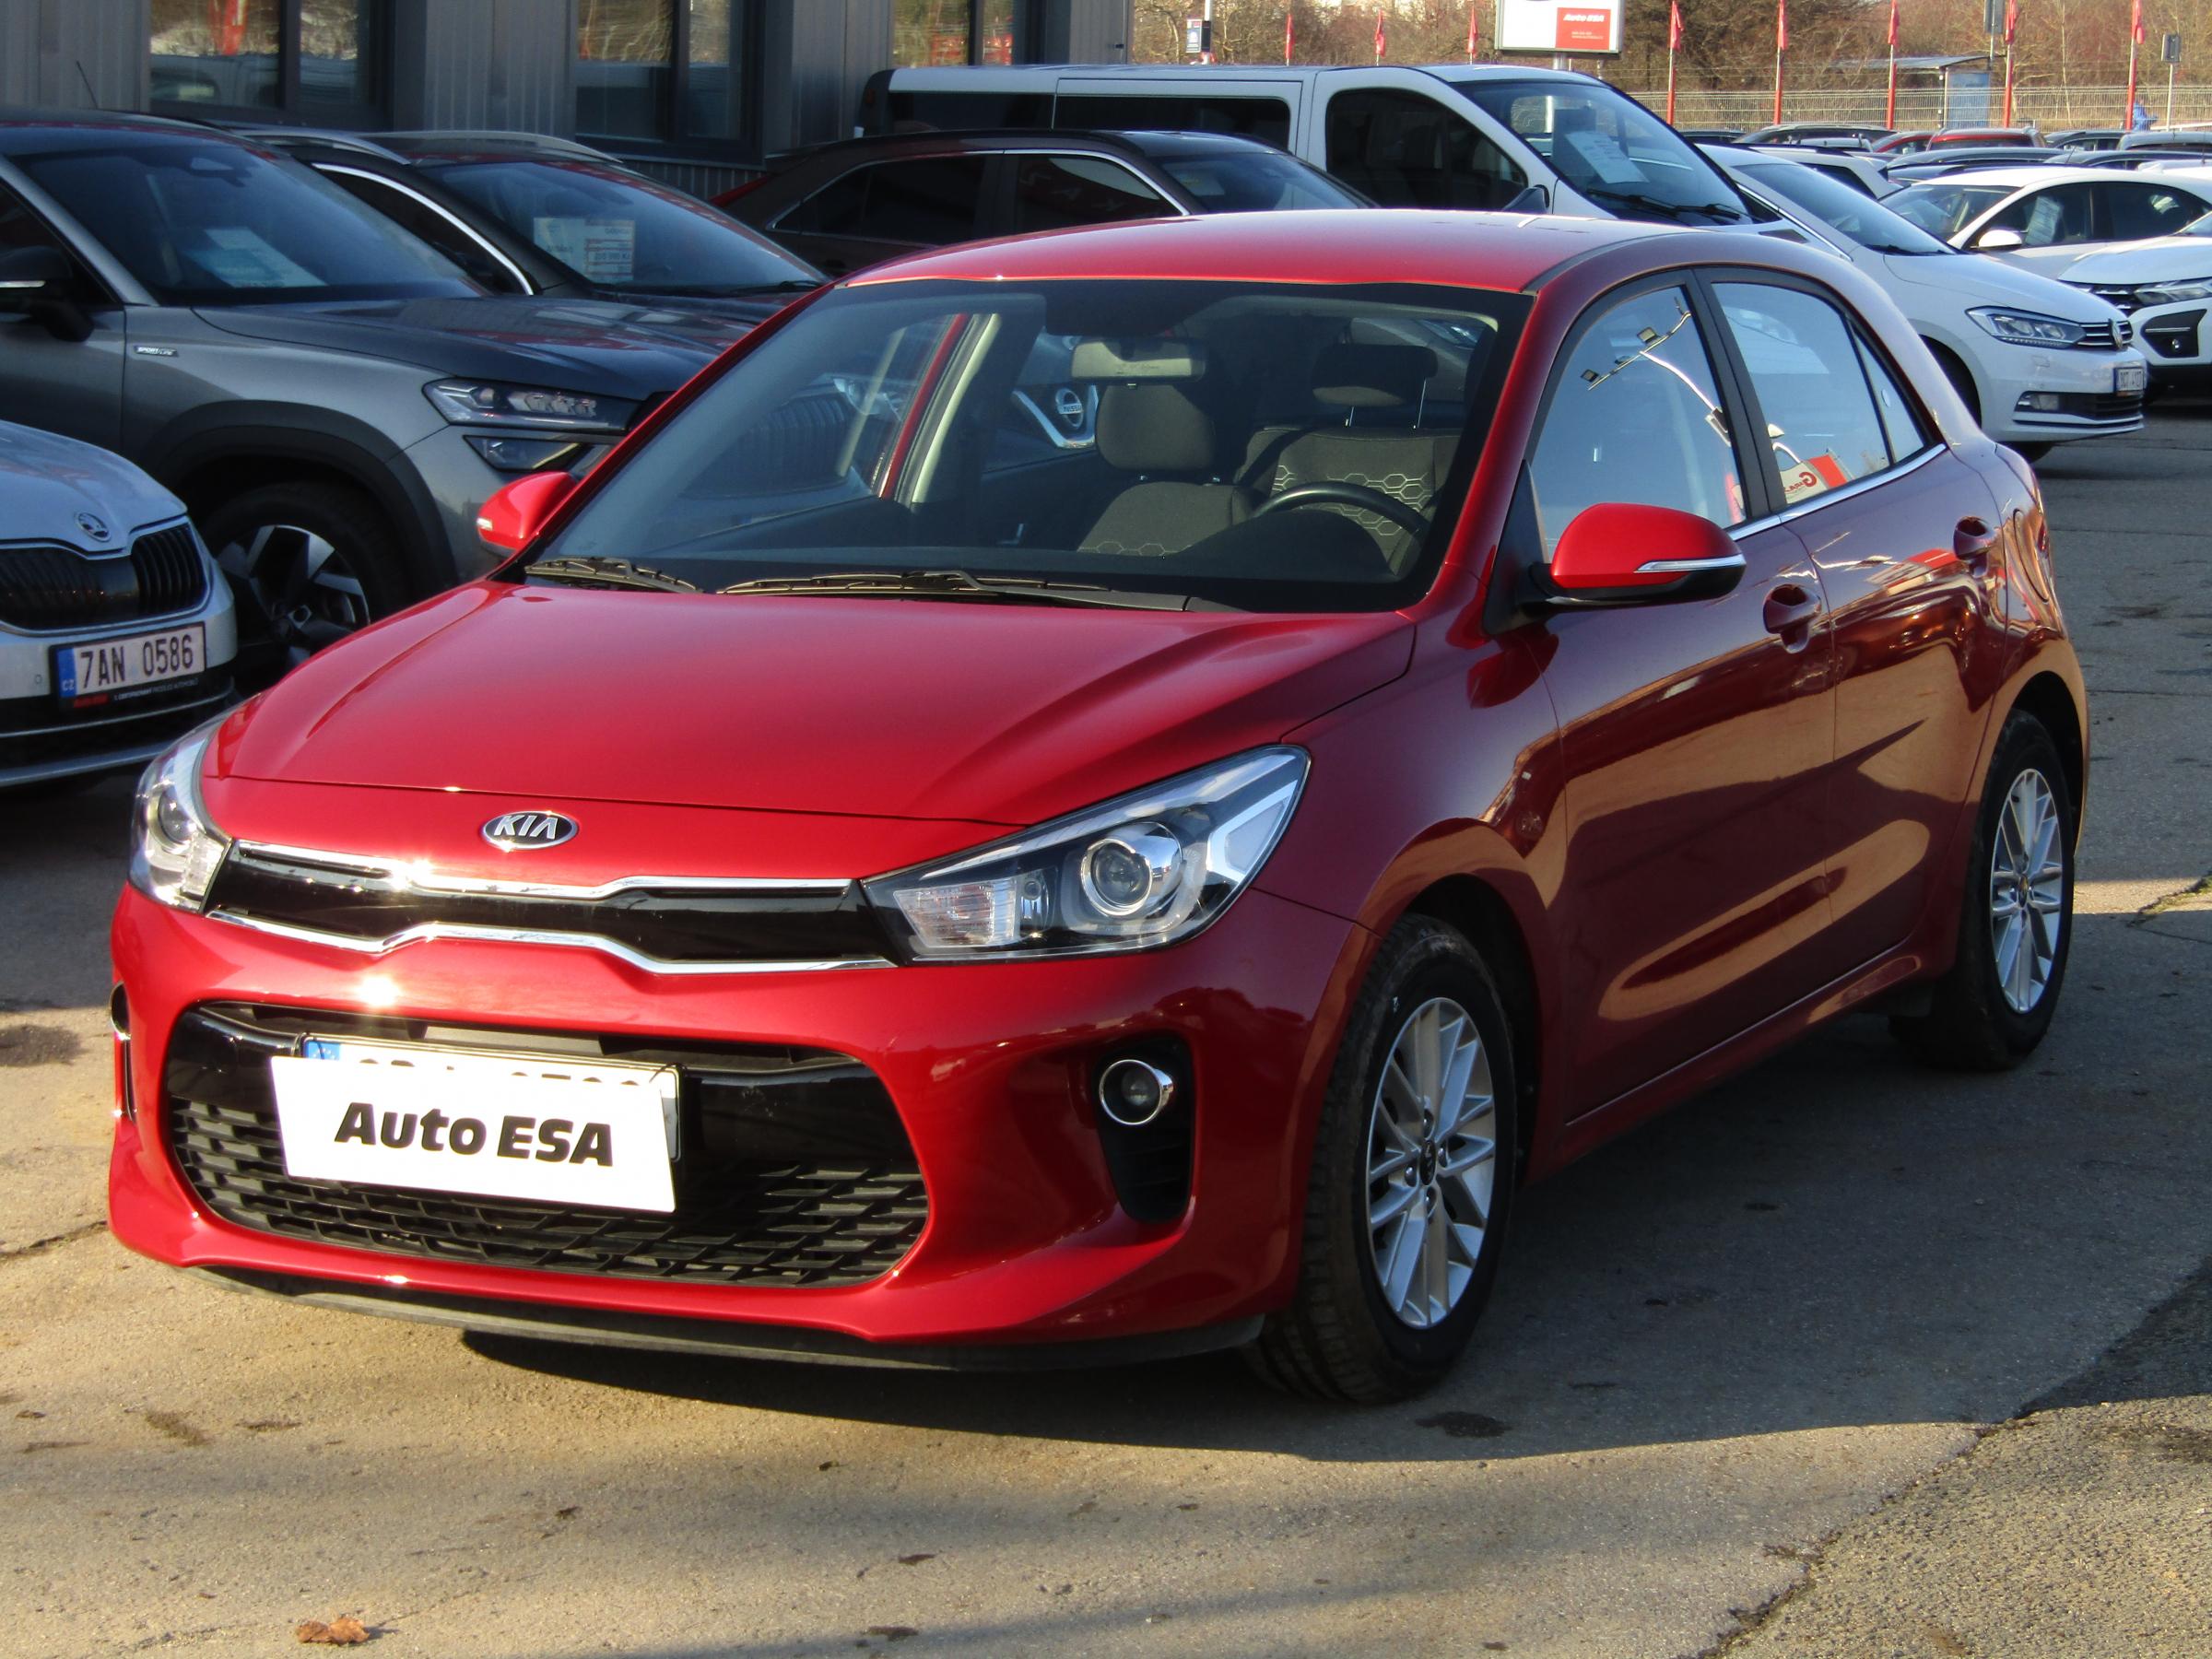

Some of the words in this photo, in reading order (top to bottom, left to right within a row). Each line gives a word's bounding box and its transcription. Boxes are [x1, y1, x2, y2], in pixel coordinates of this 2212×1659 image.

[80, 646, 125, 688] 7AN
[143, 634, 194, 677] 0586
[62, 679, 75, 691] CZ
[493, 815, 559, 840] KIA
[334, 1101, 488, 1156] Auto
[497, 1115, 614, 1167] ESA
